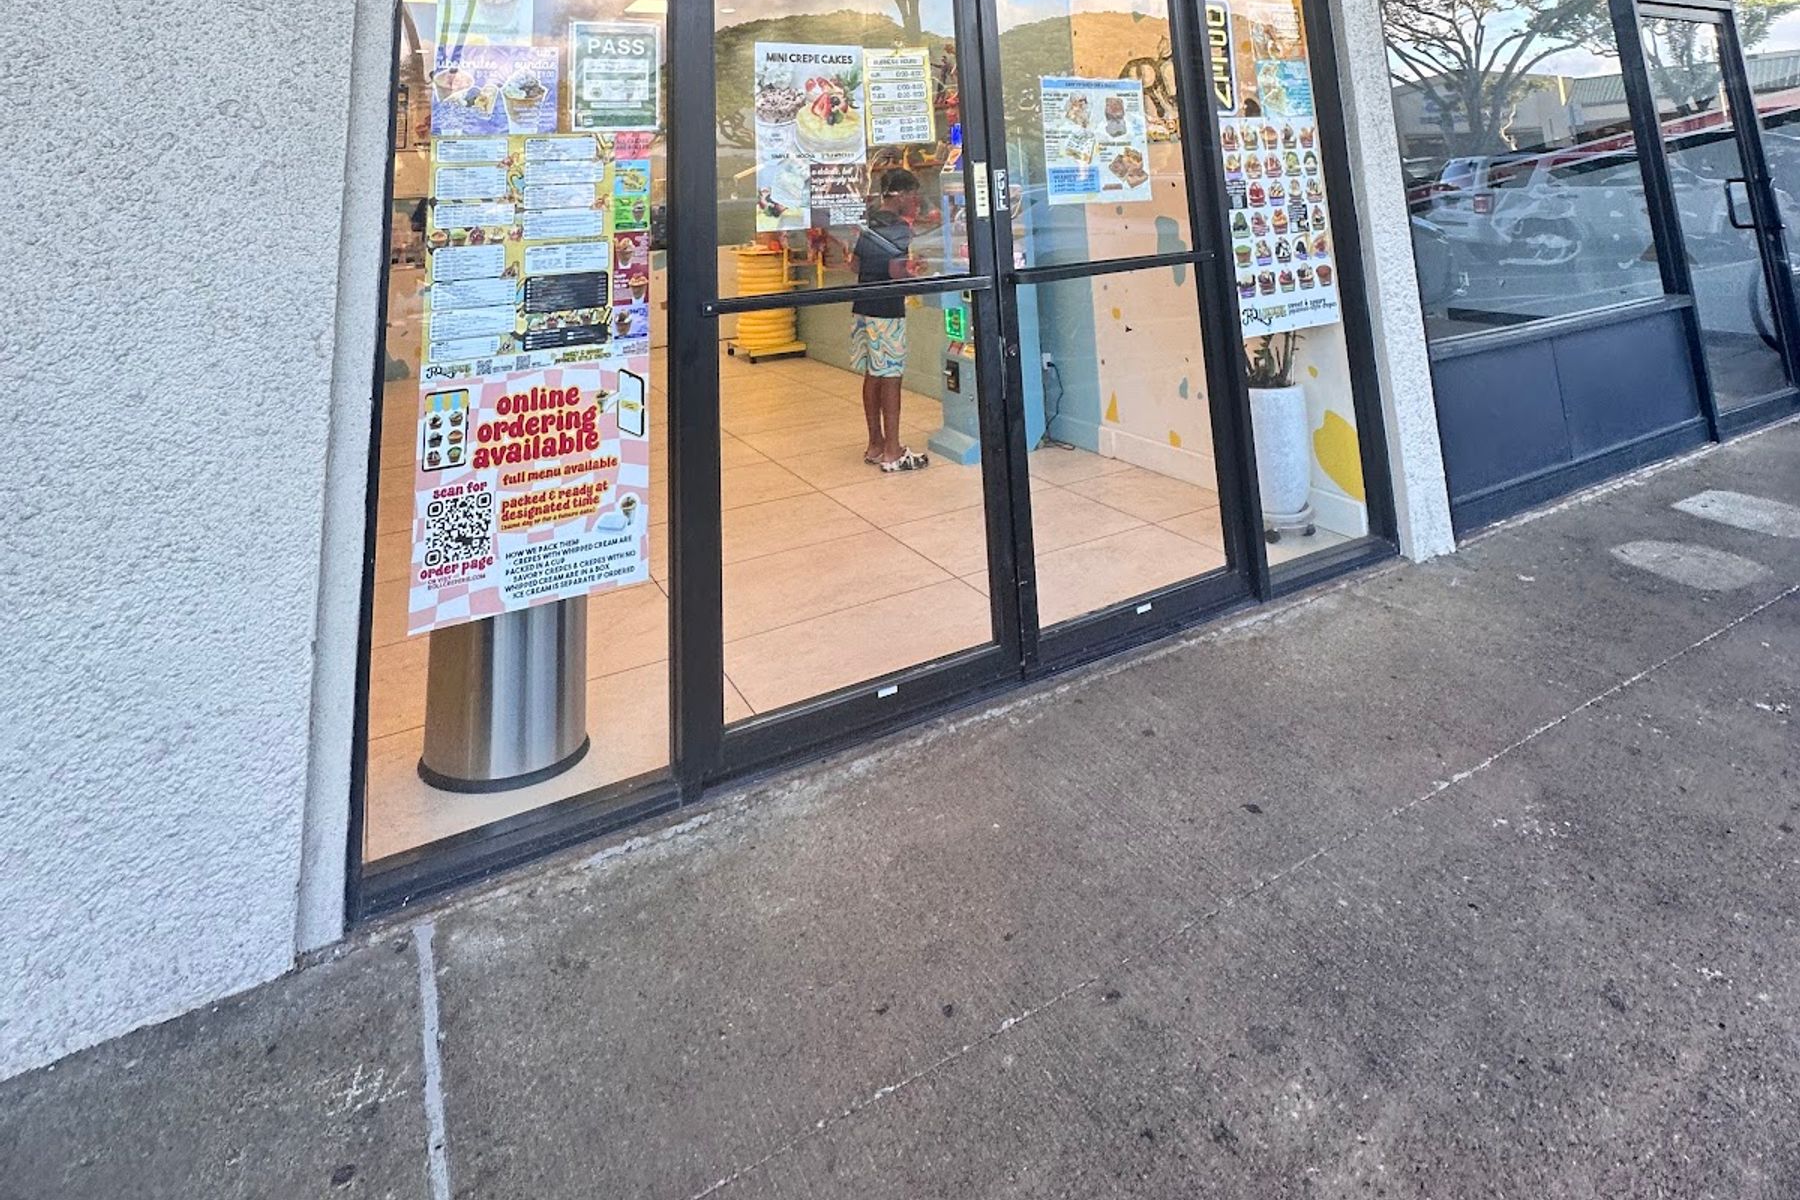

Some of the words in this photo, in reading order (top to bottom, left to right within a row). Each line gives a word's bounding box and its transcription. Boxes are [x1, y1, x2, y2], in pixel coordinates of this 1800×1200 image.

[588, 38, 645, 55] PASS
[766, 52, 788, 63] MINI
[789, 53, 820, 64] CREPE
[821, 54, 853, 64] CAKES
[997, 172, 1008, 210] PULL
[497, 387, 580, 415] online
[477, 405, 597, 443] ordering
[473, 430, 599, 469] available
[503, 471, 525, 485] full
[527, 467, 561, 481] menu
[563, 457, 618, 475] available
[433, 486, 463, 499] scan
[466, 481, 487, 493] for
[502, 490, 546, 513] packed
[558, 483, 594, 499] ready
[595, 480, 608, 492] at
[501, 500, 570, 521] designated
[572, 495, 600, 508] time
[505, 550, 525, 560] HOW
[525, 547, 537, 556] WE
[539, 542, 558, 553] PACK
[513, 555, 542, 567] CREPES
[543, 550, 561, 560] WITH
[562, 543, 594, 556] WHIPPED
[594, 538, 618, 550] CREAM
[618, 535, 633, 544] ARE
[420, 563, 459, 579] order
[461, 556, 494, 575] page
[505, 564, 535, 576] PACKED
[536, 562, 543, 570] IN
[551, 557, 566, 566] CUP
[505, 579, 538, 593] WHIPPED
[539, 574, 564, 586] CREAM
[565, 569, 580, 579] ARE
[580, 568, 588, 576] IN
[595, 563, 610, 573] BOX
[513, 571, 543, 583] SAVORY
[544, 564, 572, 576] CREPES
[580, 557, 606, 568] CREPES
[607, 553, 624, 563] WITH
[512, 590, 524, 600] ICE
[525, 584, 552, 598] CREAM
[560, 575, 595, 589] SEPARATE
[603, 566, 636, 579] ORDERED
